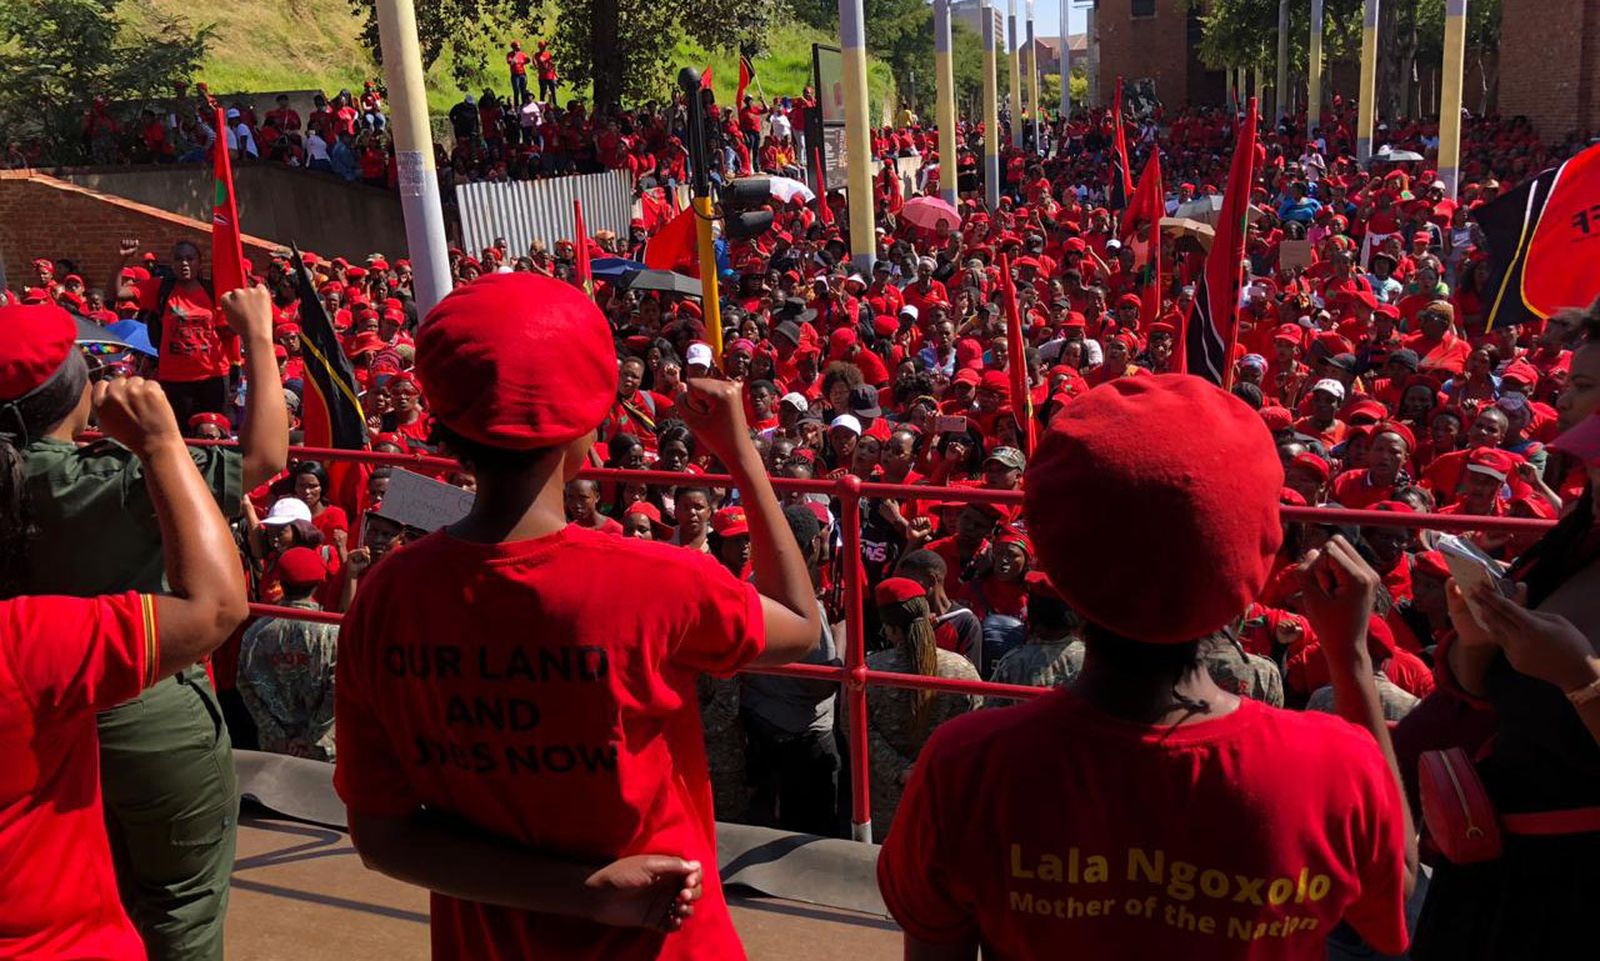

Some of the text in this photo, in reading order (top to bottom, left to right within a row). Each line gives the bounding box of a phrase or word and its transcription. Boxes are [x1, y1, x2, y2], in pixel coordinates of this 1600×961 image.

[384, 645, 608, 682] OUR LAND
[447, 695, 540, 732] AND
[506, 745, 619, 775] NOW
[1011, 844, 1332, 905] Lala Ngoxolo
[1010, 892, 1319, 941] Mother of the Nation
